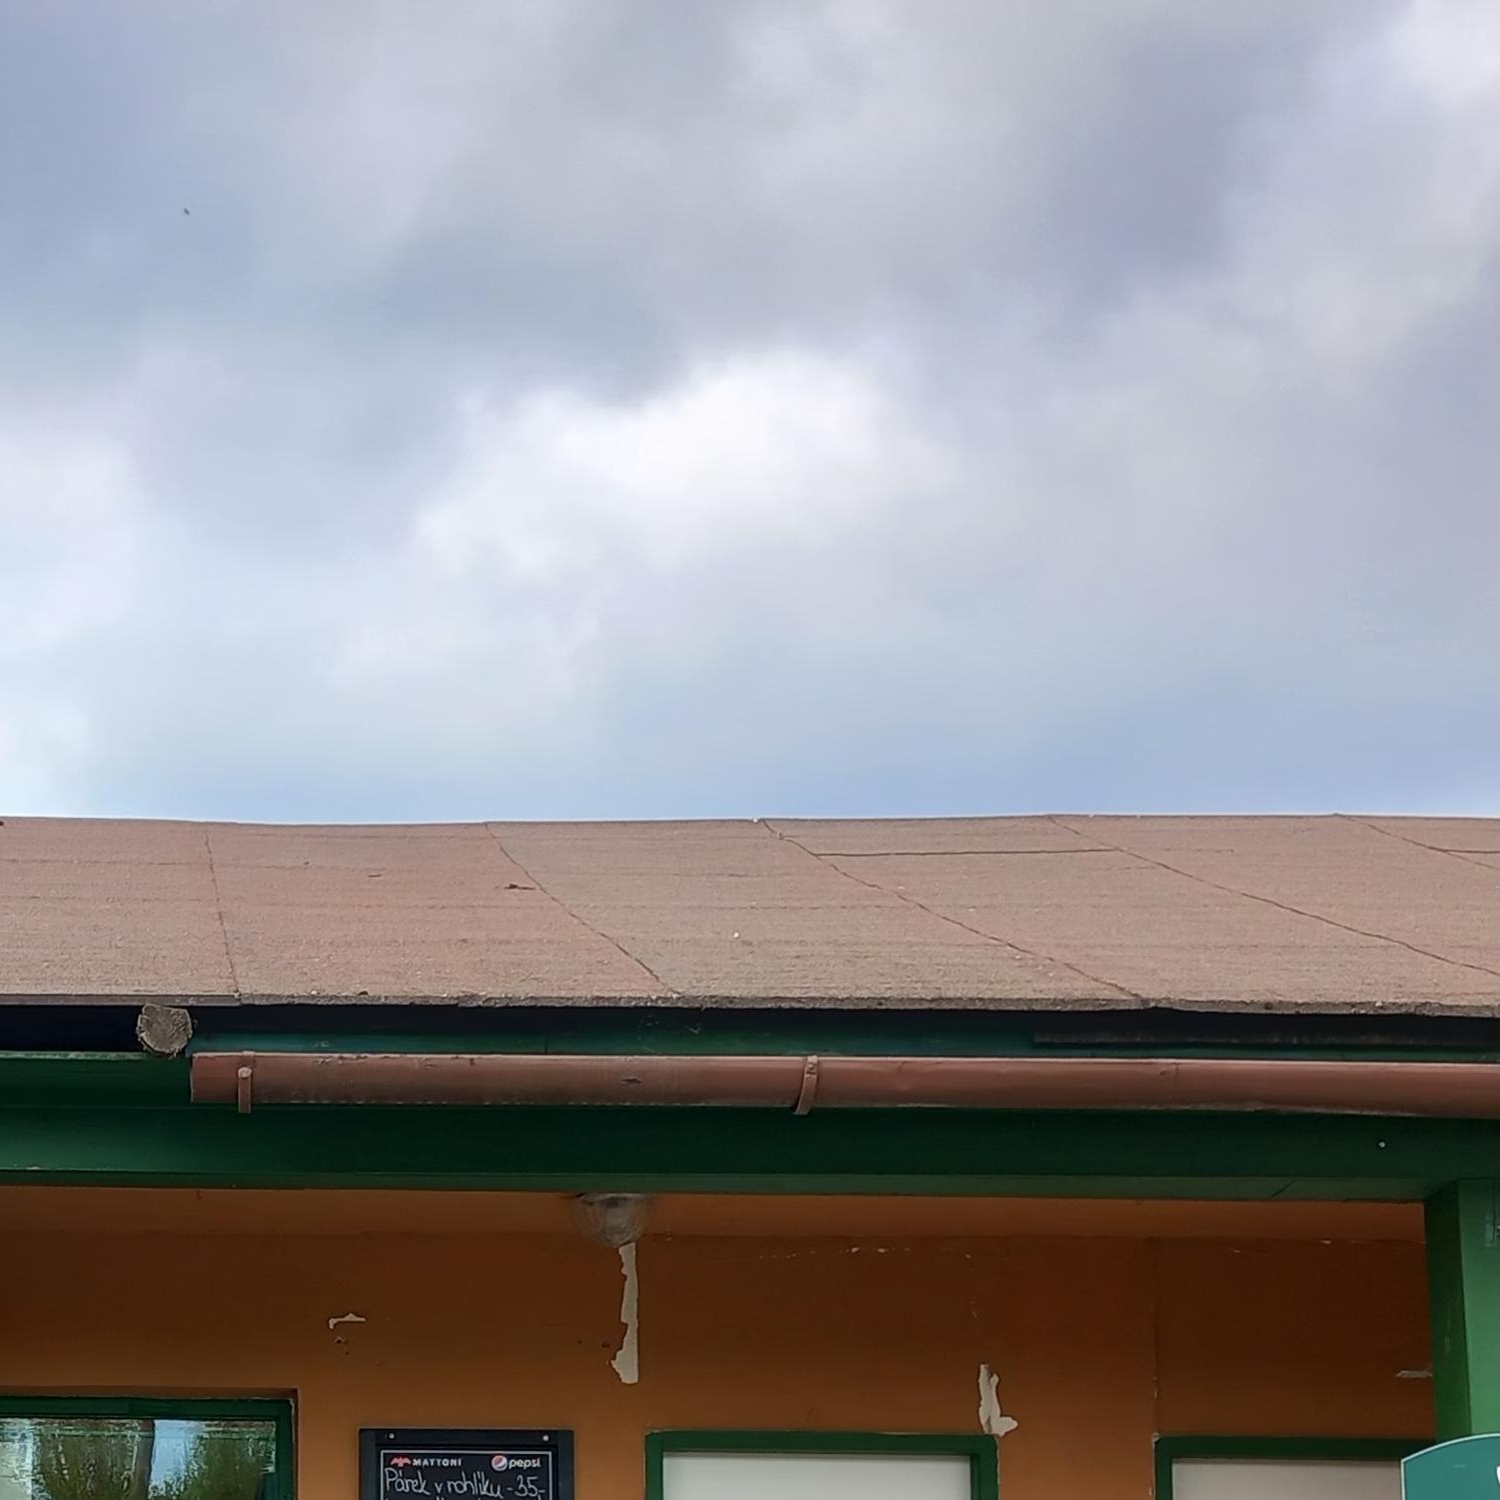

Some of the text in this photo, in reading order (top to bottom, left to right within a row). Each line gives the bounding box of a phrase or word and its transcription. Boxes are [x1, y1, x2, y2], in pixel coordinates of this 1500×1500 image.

[412, 1457, 462, 1467] MATTONI
[508, 1458, 541, 1470] pepsi
[385, 1468, 431, 1495] Párek
[435, 1482, 443, 1494] v
